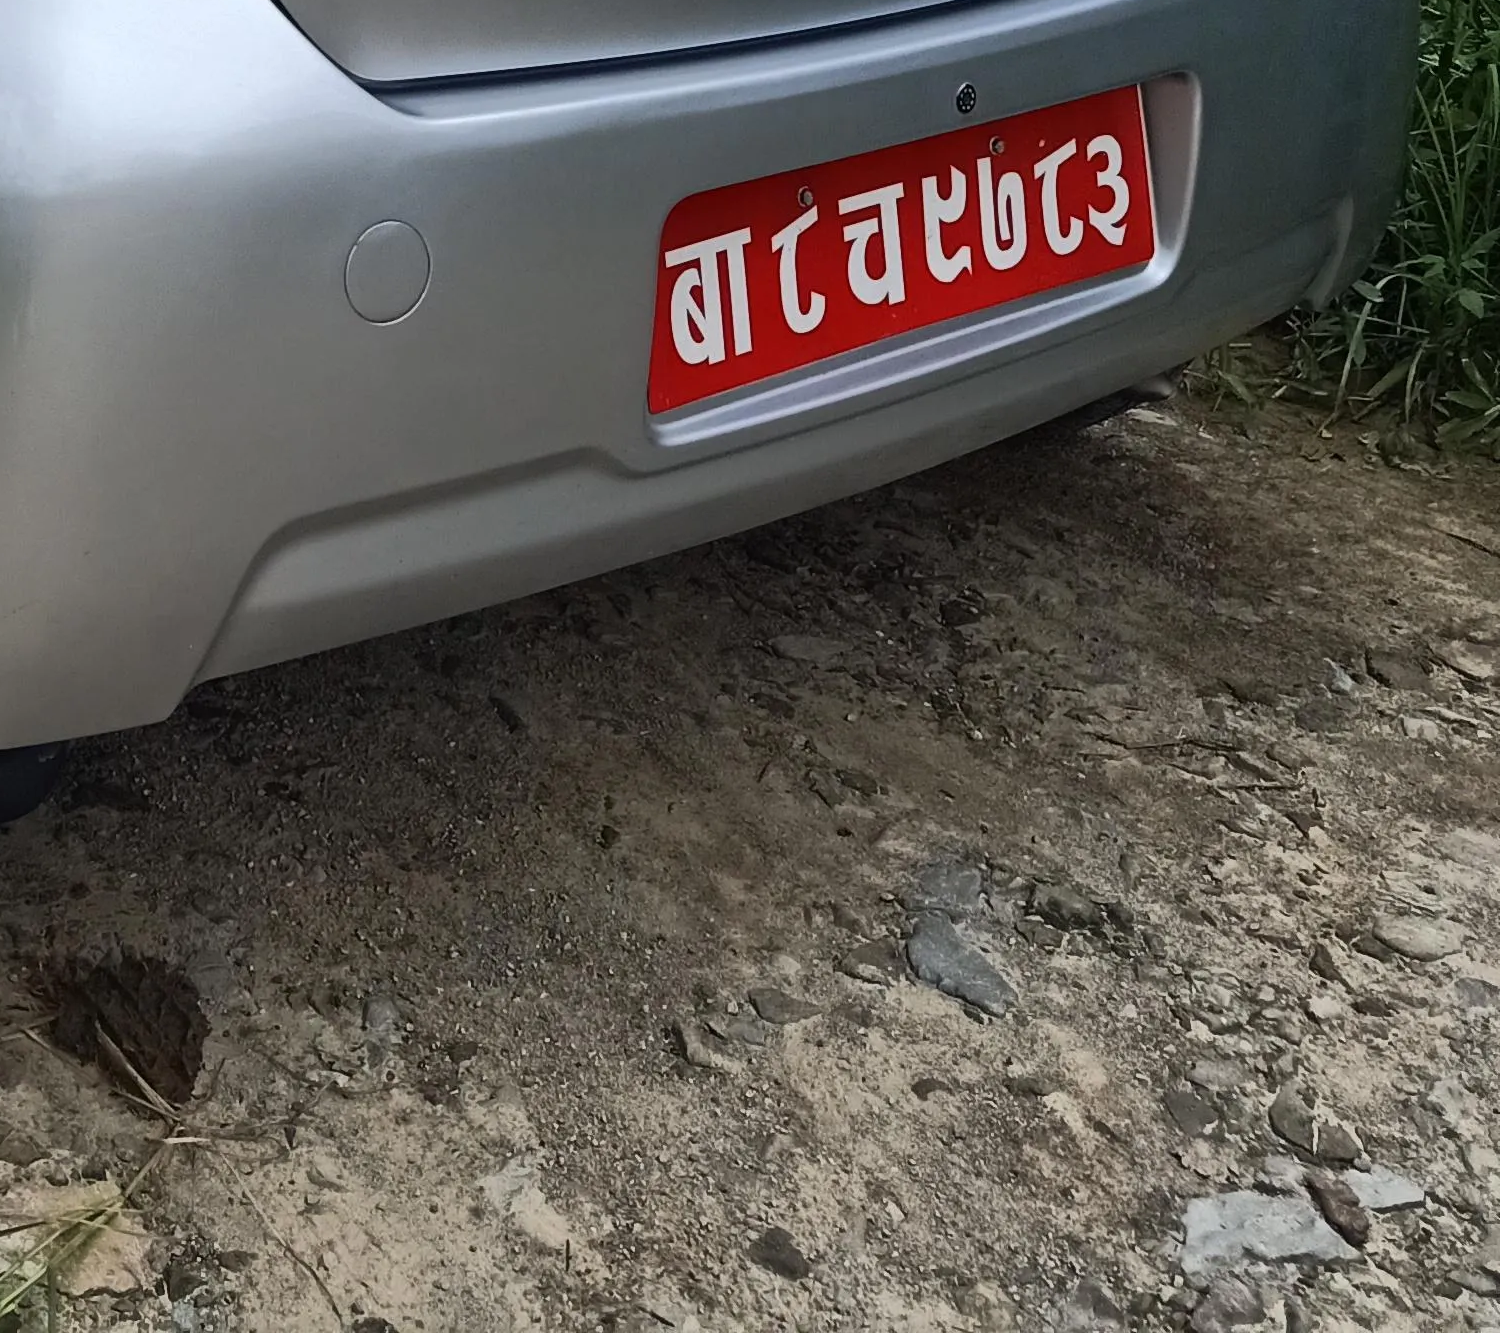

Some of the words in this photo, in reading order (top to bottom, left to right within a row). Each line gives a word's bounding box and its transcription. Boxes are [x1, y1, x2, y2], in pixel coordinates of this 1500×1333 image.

[664, 226, 753, 367] बा
[771, 204, 826, 335] ८
[838, 182, 906, 306] च
